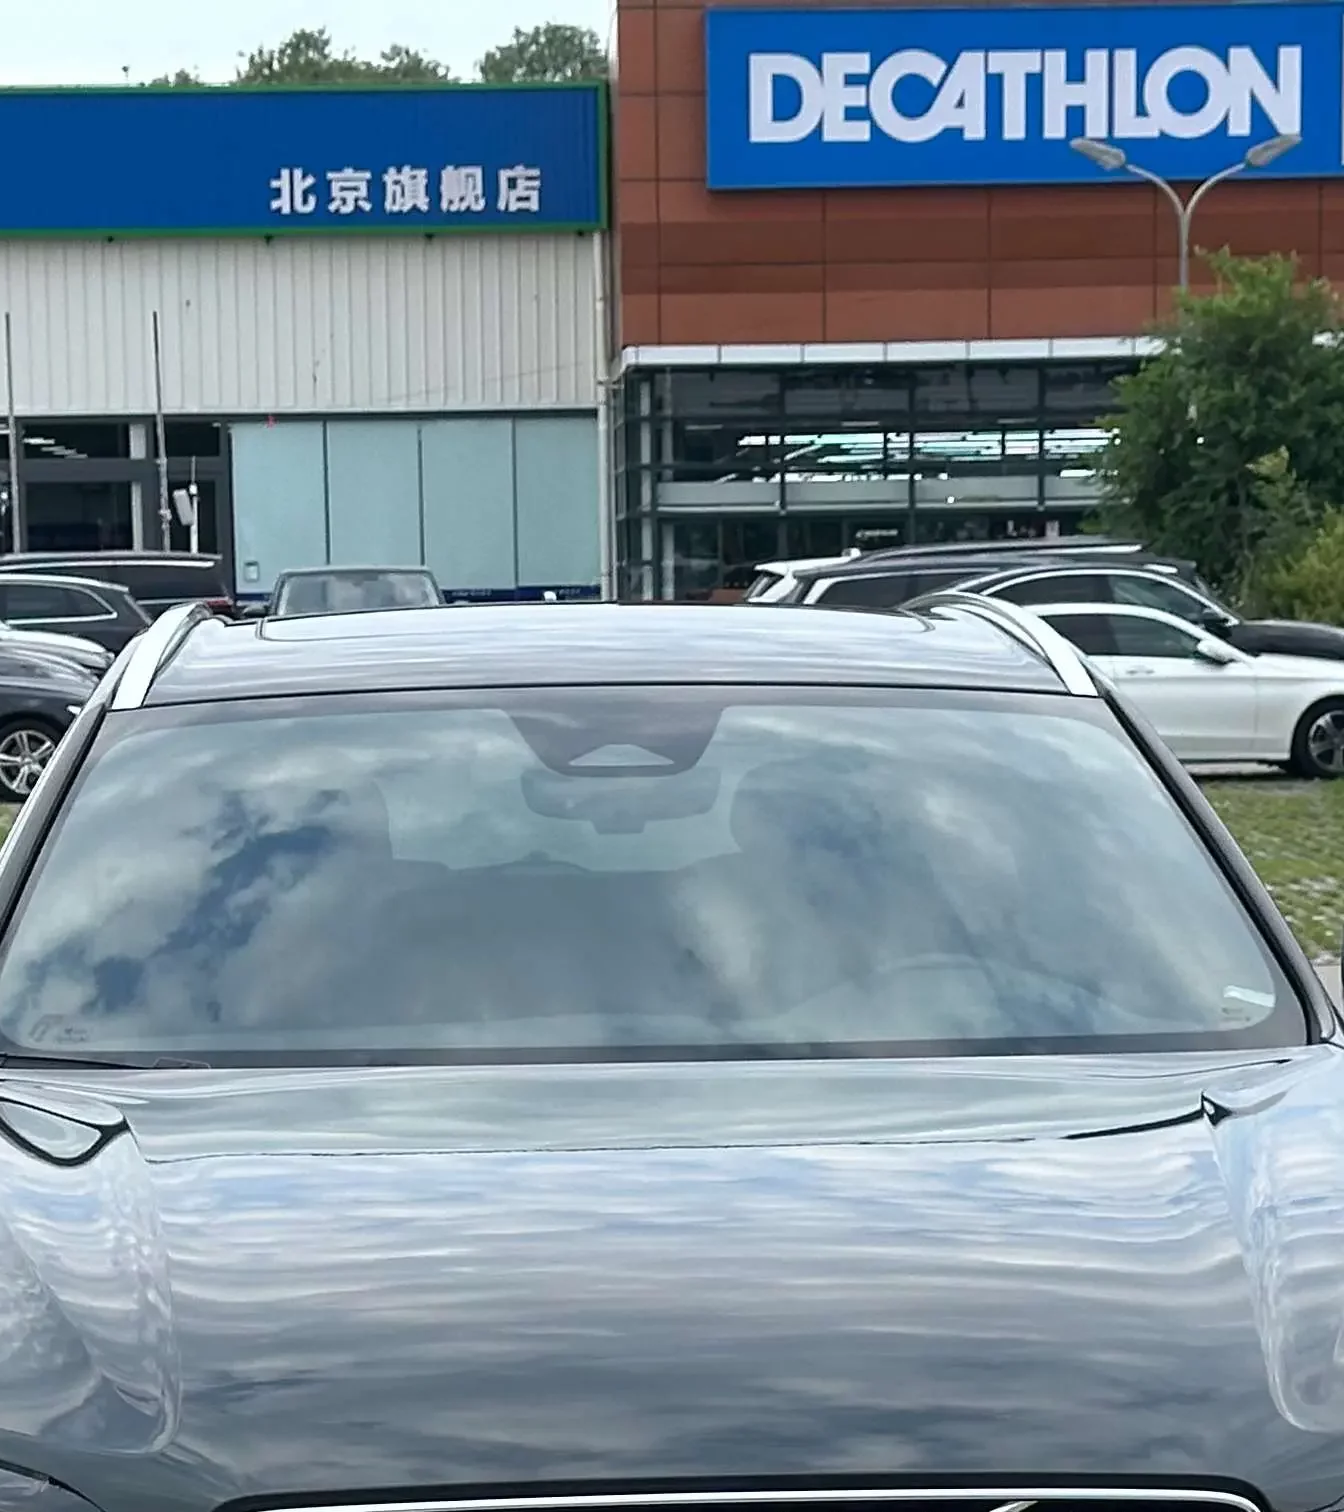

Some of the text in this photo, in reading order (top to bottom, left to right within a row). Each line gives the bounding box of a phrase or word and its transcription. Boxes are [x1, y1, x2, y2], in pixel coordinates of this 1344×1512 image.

[748, 45, 1302, 143] DECATHLON
[269, 165, 542, 215] 北京旗舰店
